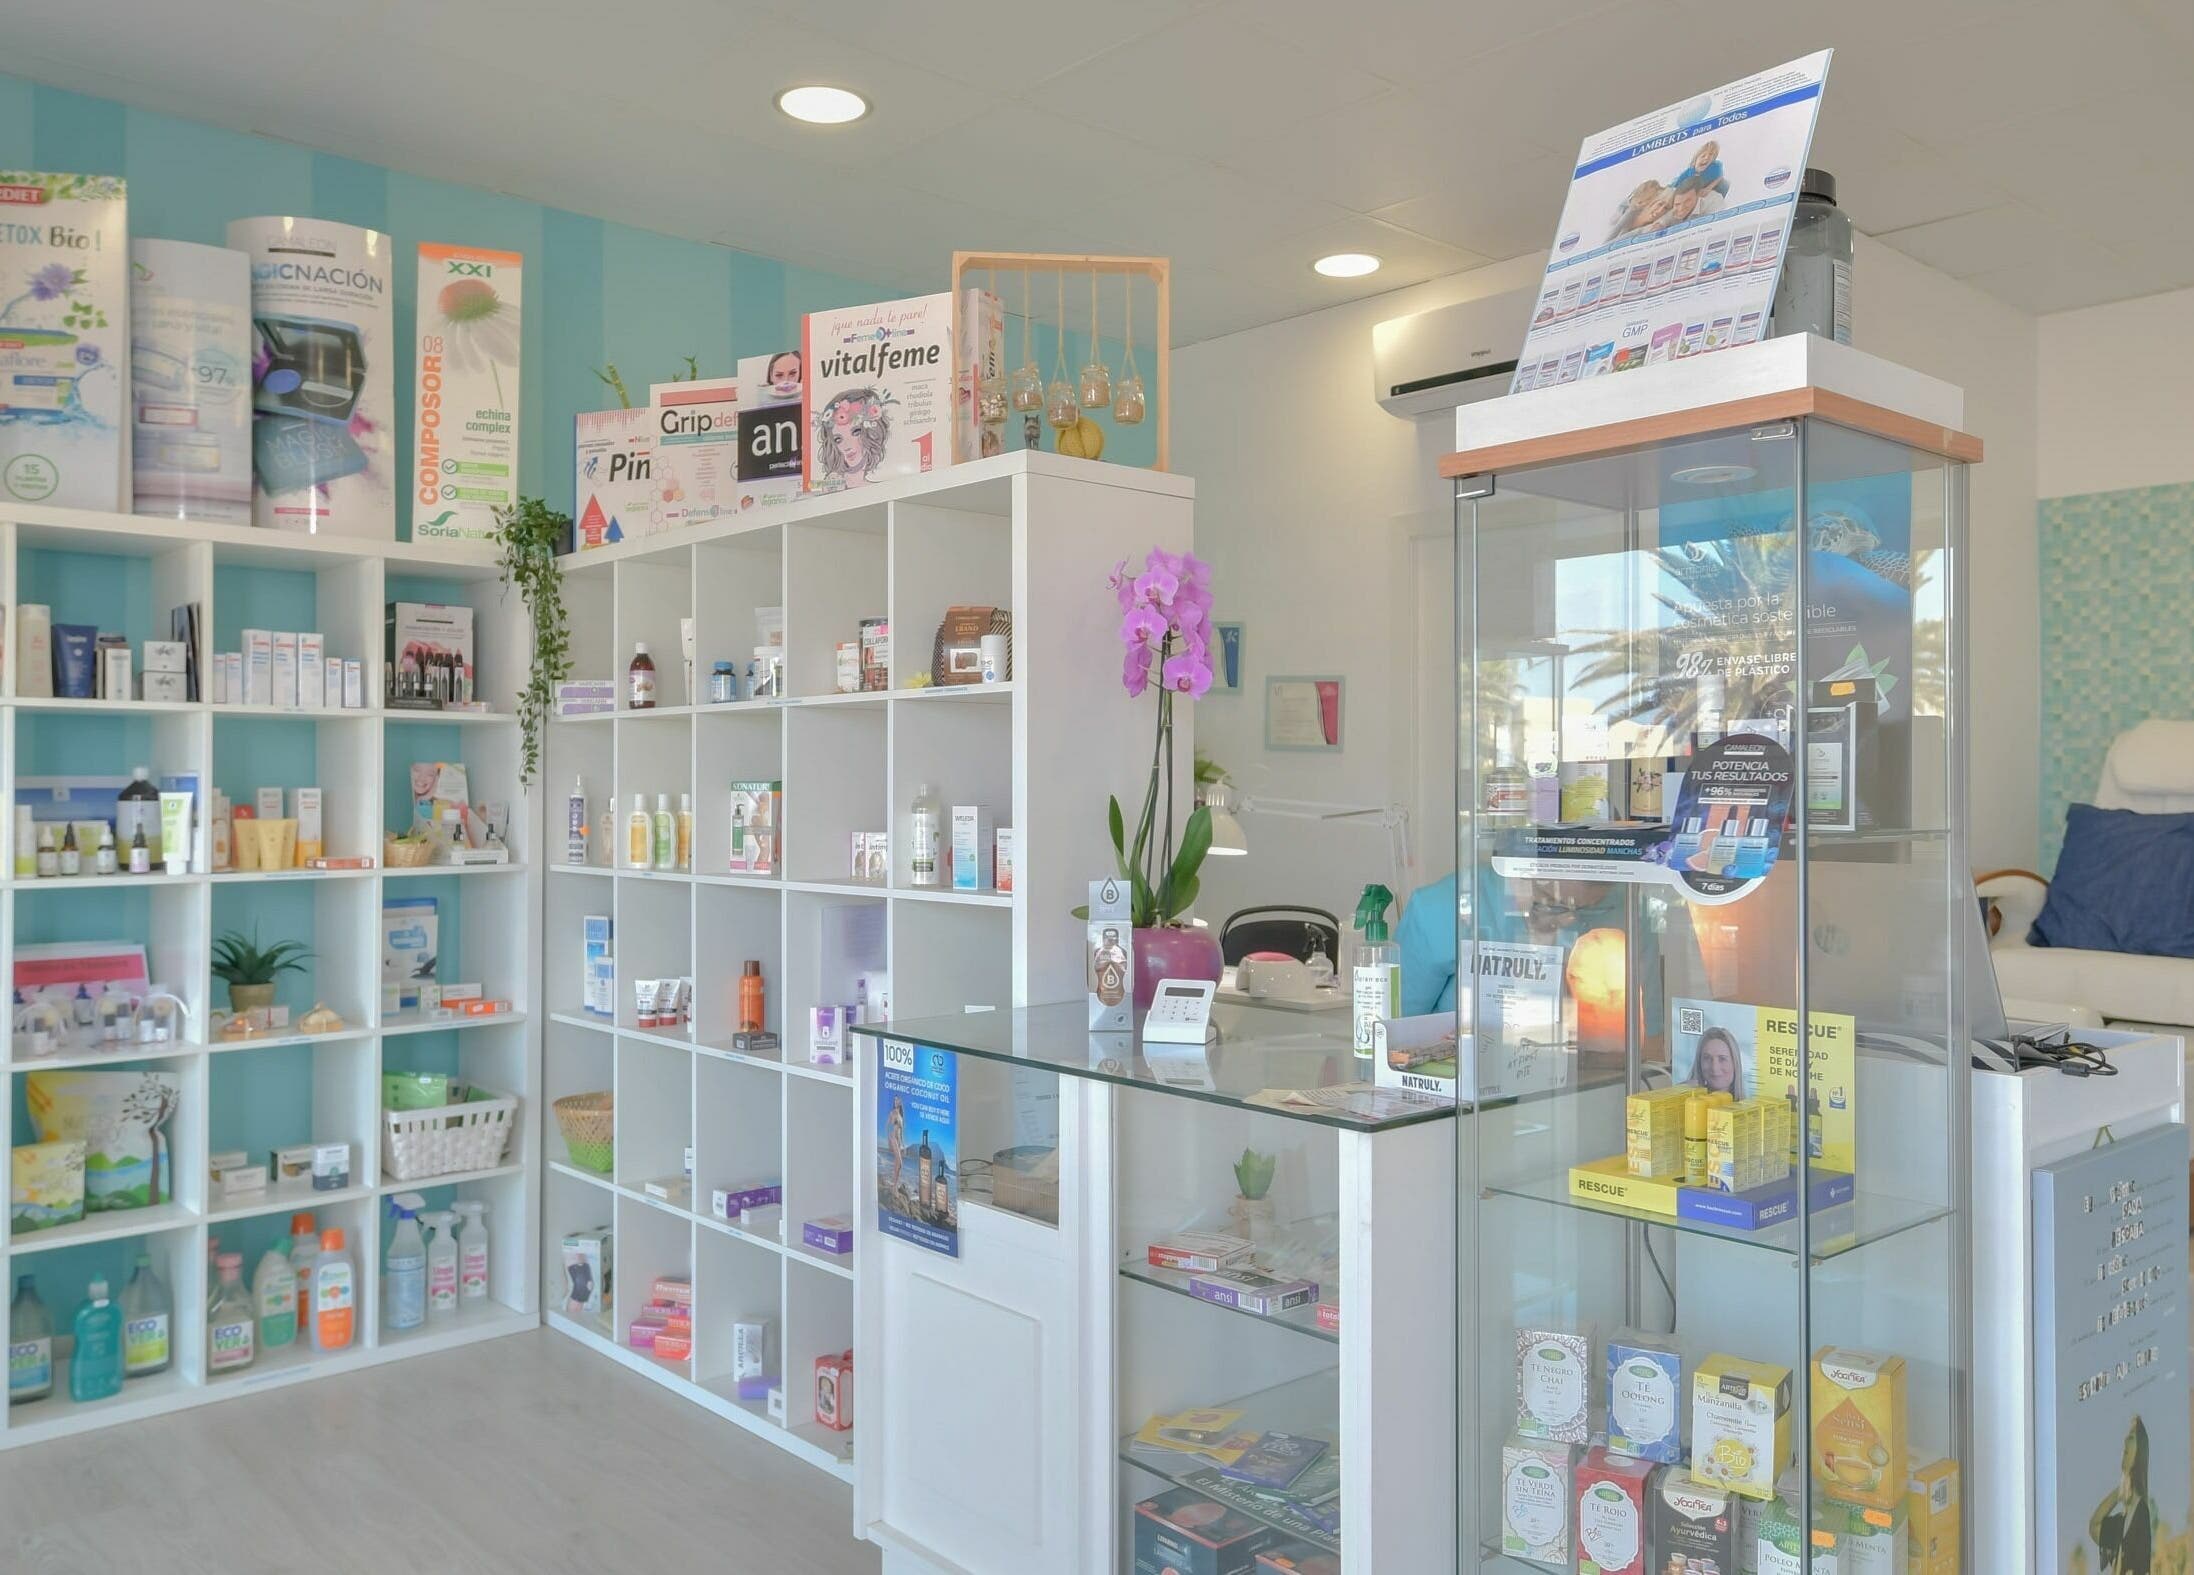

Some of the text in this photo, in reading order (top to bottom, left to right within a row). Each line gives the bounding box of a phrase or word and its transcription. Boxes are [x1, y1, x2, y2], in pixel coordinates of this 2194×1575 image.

[1631, 111, 1748, 157] LAMBERTS para Todos
[50, 226, 90, 249] Bio
[447, 261, 491, 278] XXI
[857, 308, 883, 327] nada
[887, 310, 897, 323] te
[1622, 323, 1648, 338] GMP
[423, 335, 443, 354] 08
[821, 342, 941, 379] vitalfeme
[475, 409, 512, 421] echina
[418, 355, 442, 505] COMPOSOR
[465, 421, 512, 434] complex
[911, 431, 933, 473] 1
[23, 463, 41, 475] 15
[1674, 592, 1779, 613] Apuesta por la
[1717, 653, 1797, 666] ENVASE LIBRE
[1717, 664, 1790, 677] DE PLÁSTICO
[1712, 761, 1769, 771] POTENCIA
[1691, 771, 1788, 782] TUS RESULTADOS
[1525, 837, 1635, 846] TRATAMIENTOS CONCENTRADOS
[1559, 846, 1642, 855] LUMINOSIDAD MANCHAS
[1708, 883, 1725, 891] días
[885, 1044, 913, 1066] 100%
[1769, 1057, 1782, 1066] DE
[1769, 1067, 1782, 1076] DE
[934, 1082, 950, 1093] COCO
[1402, 1075, 1441, 1092] NATRULY.
[884, 1081, 950, 1104] ORGANIC COCONUT OIL
[1579, 1180, 1625, 1197] RESCUE
[1759, 1203, 1788, 1220] RESCUE
[1214, 1290, 1233, 1304] ansi
[128, 1320, 156, 1334] ECO
[215, 1325, 242, 1340] ECO
[1543, 1365, 1574, 1376] NEGRO
[1541, 1375, 1564, 1385] CHAI
[1621, 1391, 1665, 1405] OOLONG
[1697, 1394, 1742, 1411] Manzanilla
[1719, 1445, 1745, 1467] Bio
[1516, 1486, 1528, 1494] SIN
[1528, 1480, 1554, 1490] VERDE
[1195, 1478, 1206, 1486] El
[1209, 1483, 1261, 1511] Misterio
[1263, 1507, 1280, 1520] de
[1282, 1518, 1307, 1532] una
[1603, 1506, 1627, 1518] ROJO
[1670, 1526, 1717, 1541] Ayurvédica
[1855, 1541, 1888, 1555] MENTA
[1765, 1555, 1794, 1567] POLEO
